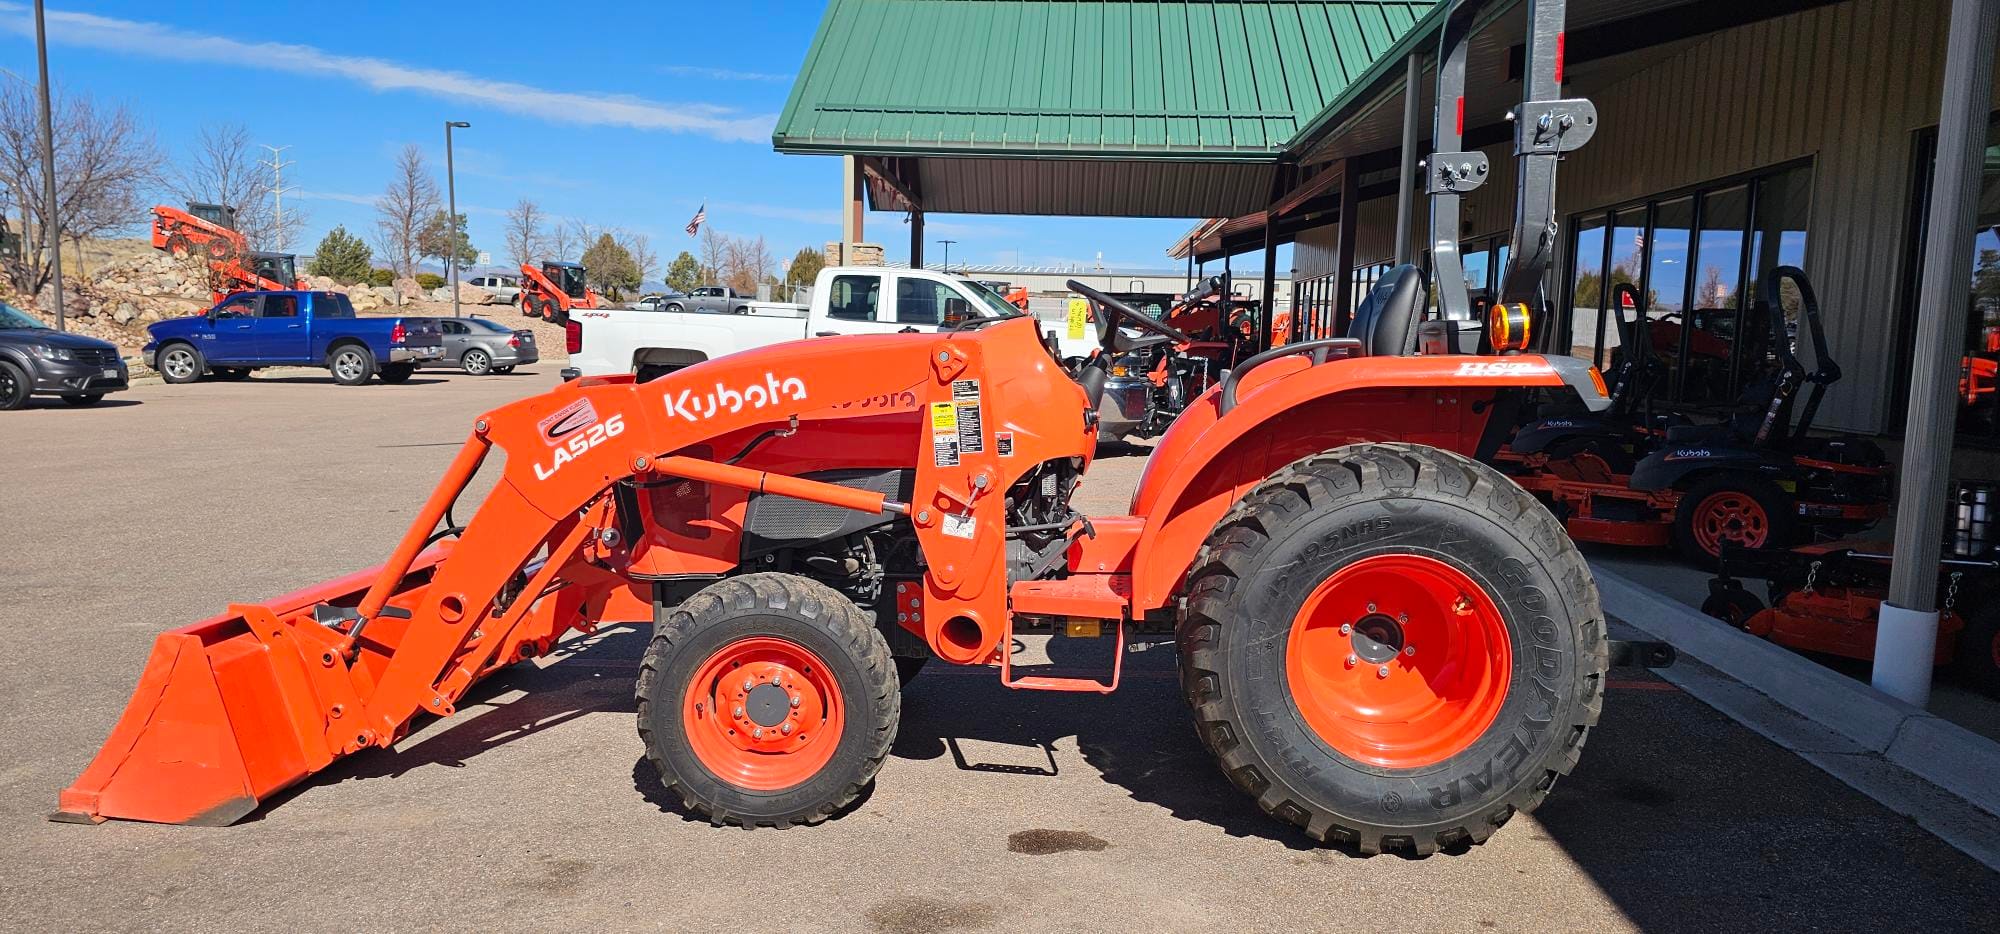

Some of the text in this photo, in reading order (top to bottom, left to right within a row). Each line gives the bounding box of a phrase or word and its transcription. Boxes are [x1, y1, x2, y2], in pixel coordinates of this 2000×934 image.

[1456, 362, 1532, 377] HST
[663, 371, 807, 422] Kubota
[533, 413, 625, 480] LA526
[1677, 449, 1711, 457] Kubota
[1427, 557, 1562, 811] GOODYEAR
